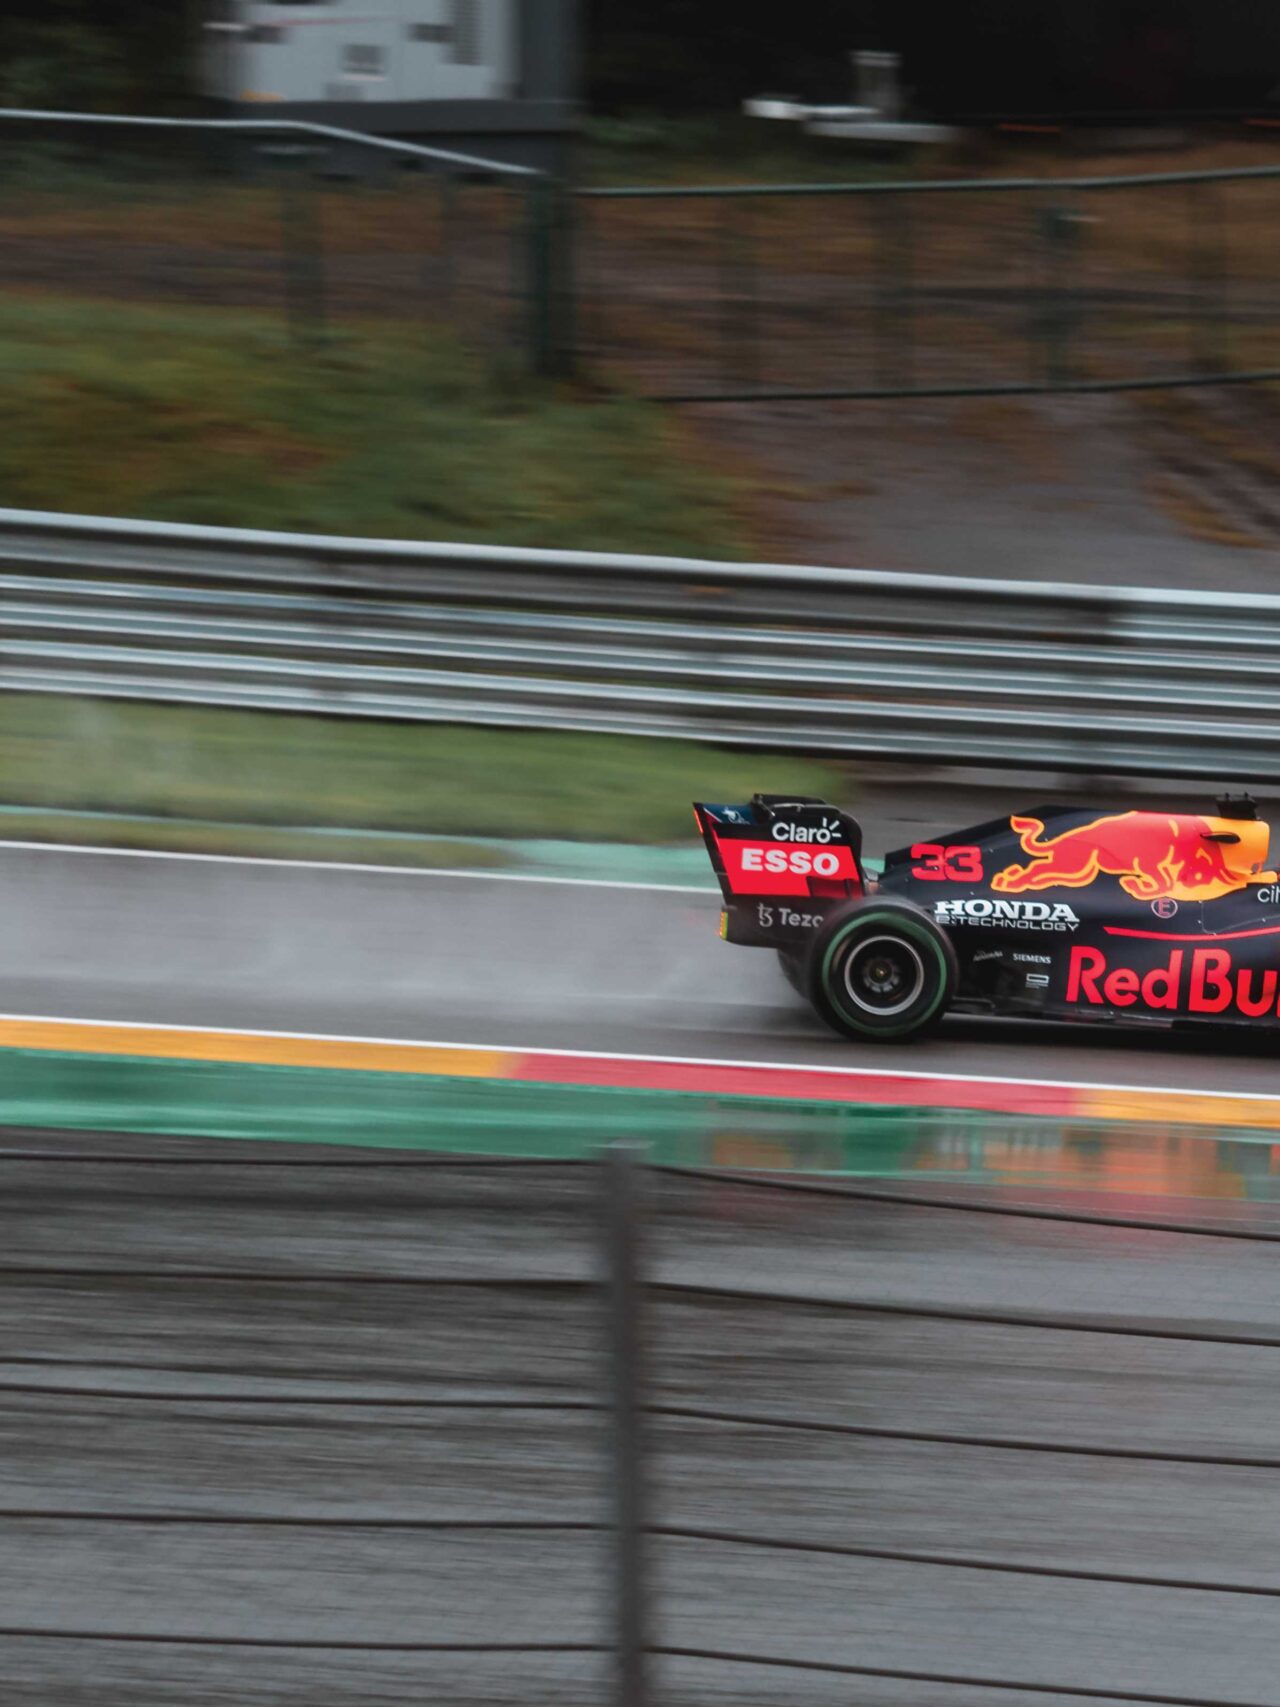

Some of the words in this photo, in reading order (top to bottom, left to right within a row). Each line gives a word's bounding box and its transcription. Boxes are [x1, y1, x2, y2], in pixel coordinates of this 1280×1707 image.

[771, 821, 831, 843] Claro
[741, 848, 839, 876] ESSO
[911, 844, 984, 882] 33
[934, 899, 1080, 922] HONDA
[1012, 953, 1052, 964] SIEMENS
[1065, 946, 1183, 1010] Red
